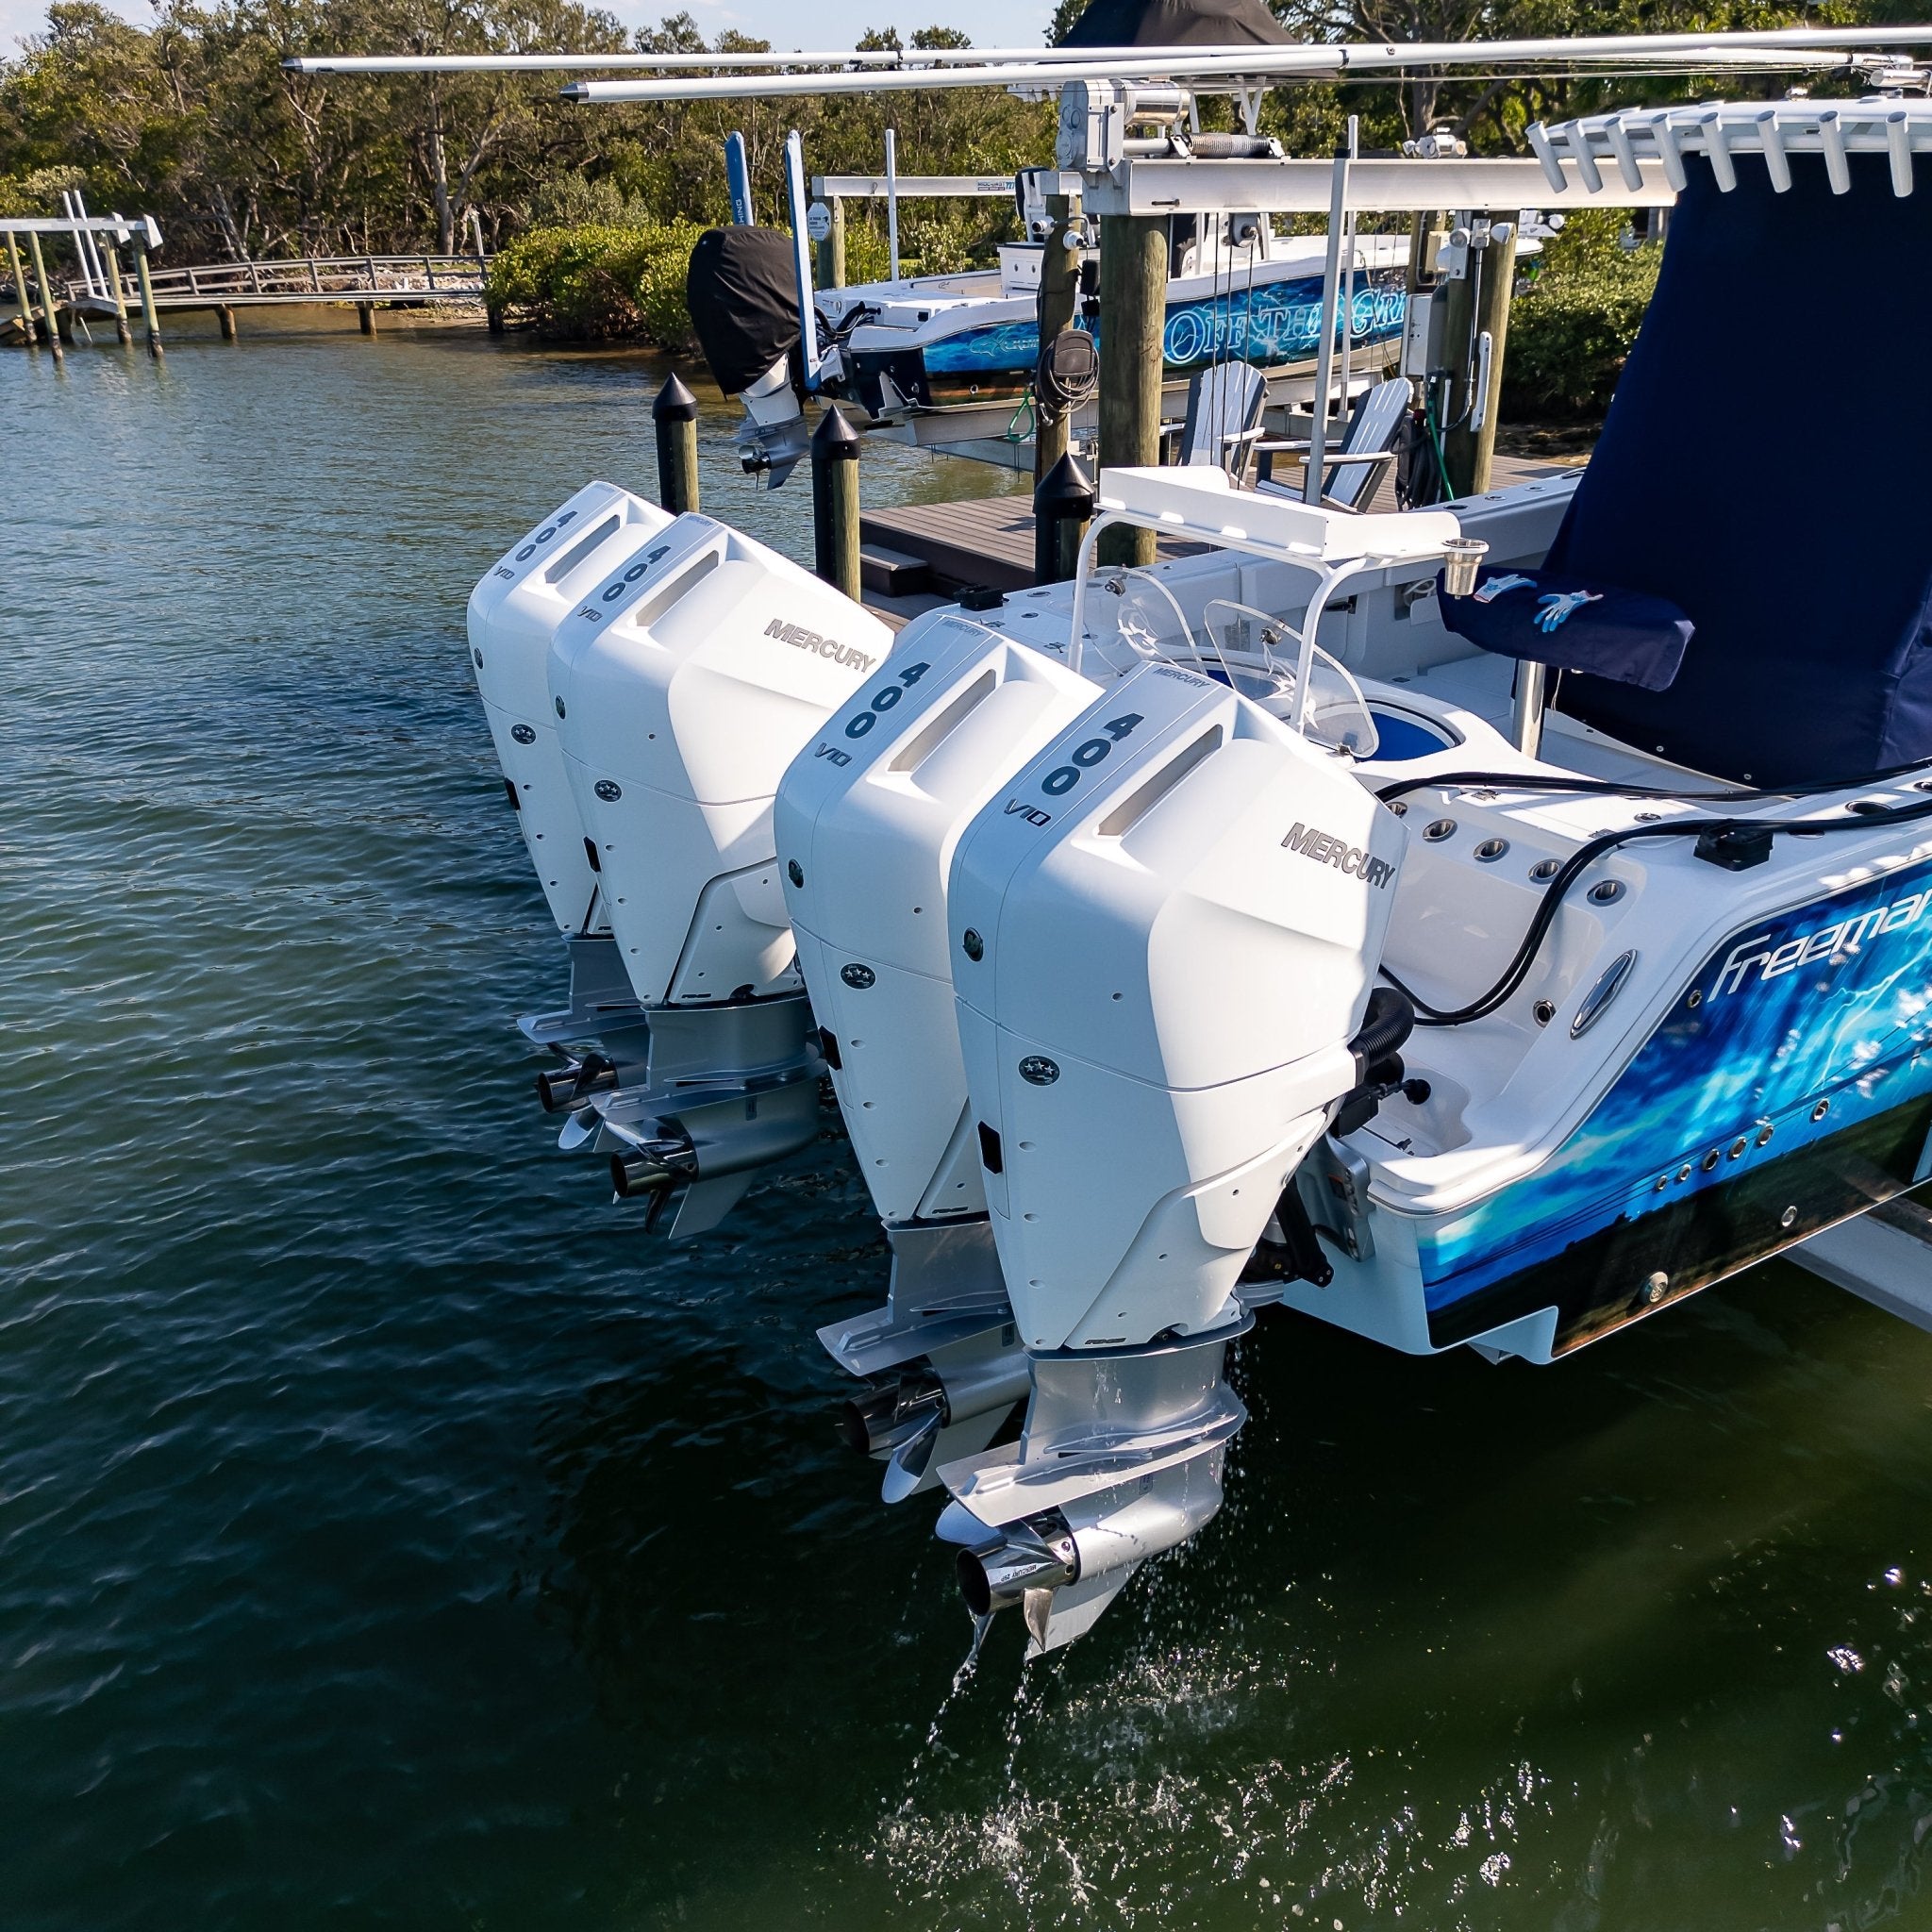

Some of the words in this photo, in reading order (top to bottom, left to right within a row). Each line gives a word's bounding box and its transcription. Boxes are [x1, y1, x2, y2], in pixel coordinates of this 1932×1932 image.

[1163, 310, 1248, 364] OFF
[602, 545, 672, 602] 400
[764, 619, 876, 673] MERCURY
[844, 661, 931, 740] 400
[1153, 667, 1212, 690] MERCURY
[1041, 712, 1144, 796] 400
[1281, 823, 1396, 890] MERCURY
